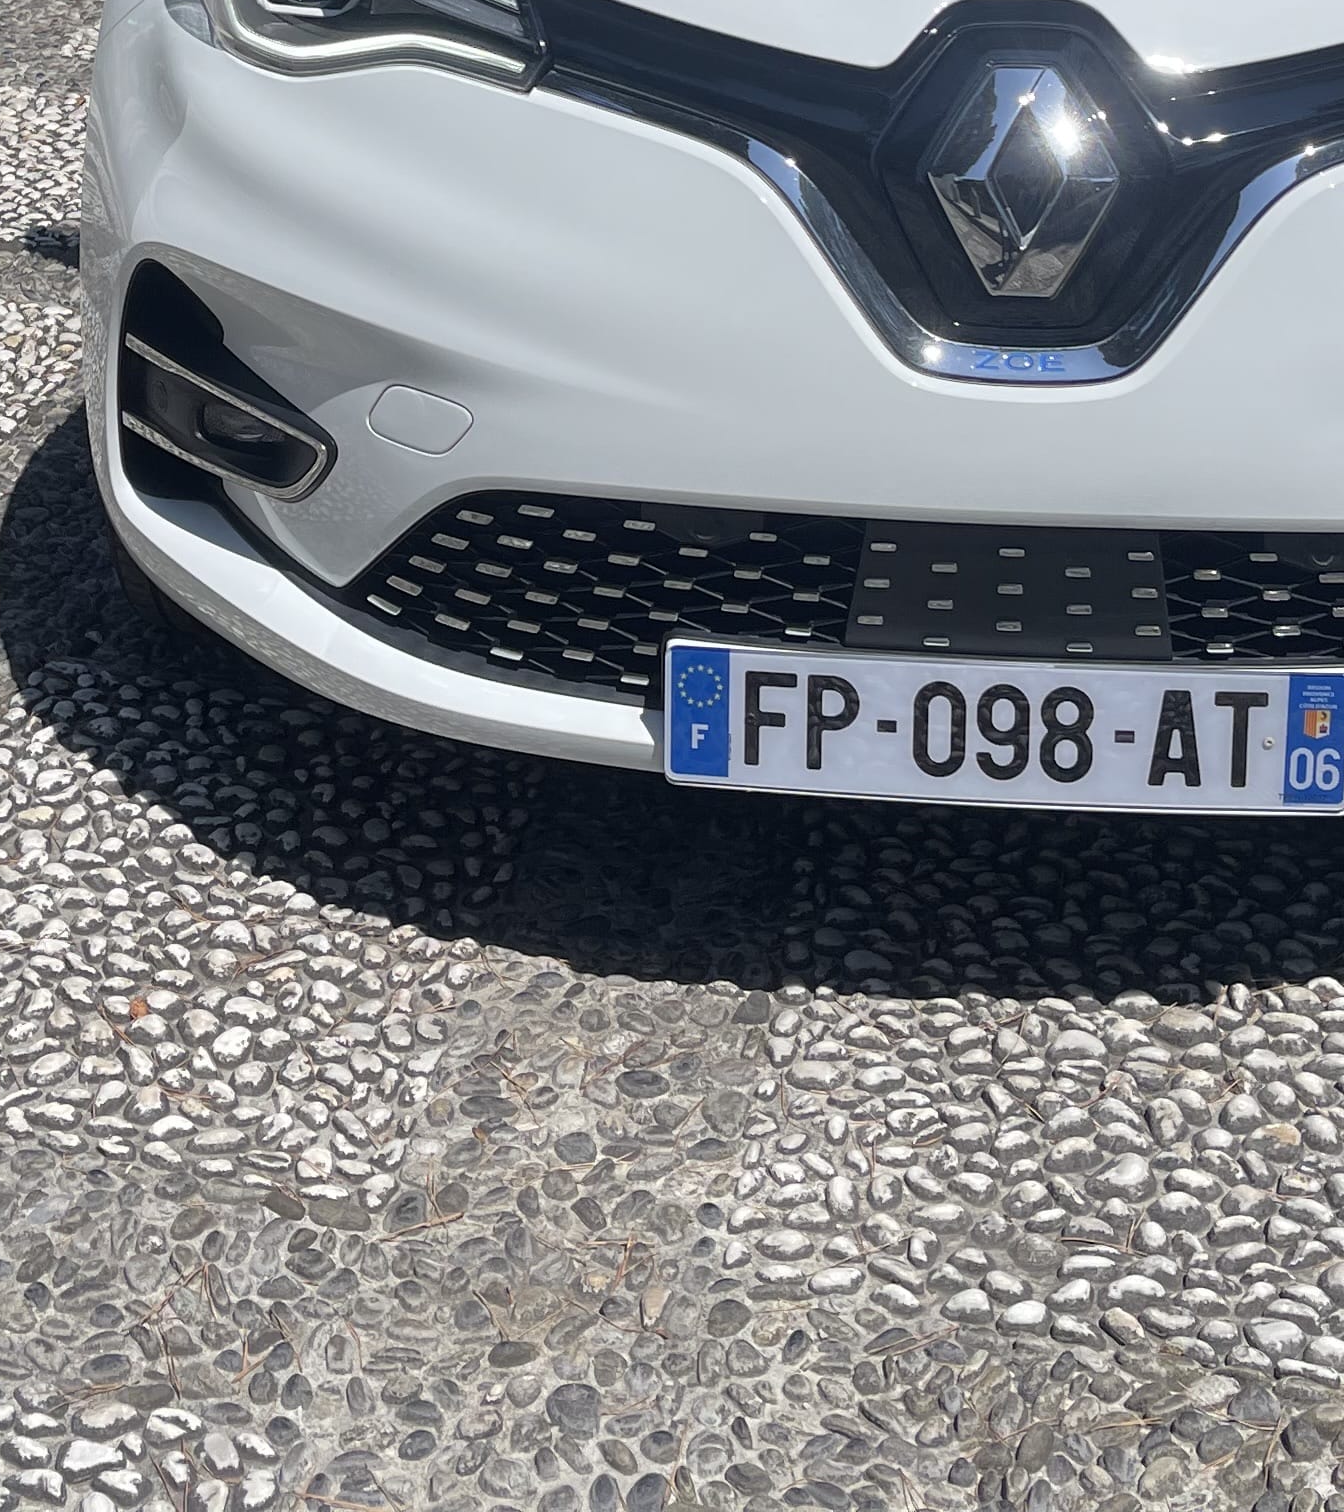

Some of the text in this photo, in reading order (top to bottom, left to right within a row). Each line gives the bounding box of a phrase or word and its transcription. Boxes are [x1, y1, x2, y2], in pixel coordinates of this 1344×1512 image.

[972, 350, 1066, 373] ZOE
[691, 723, 709, 750] F
[744, 670, 1269, 788] FP-098-AT
[1288, 746, 1341, 791] 06
